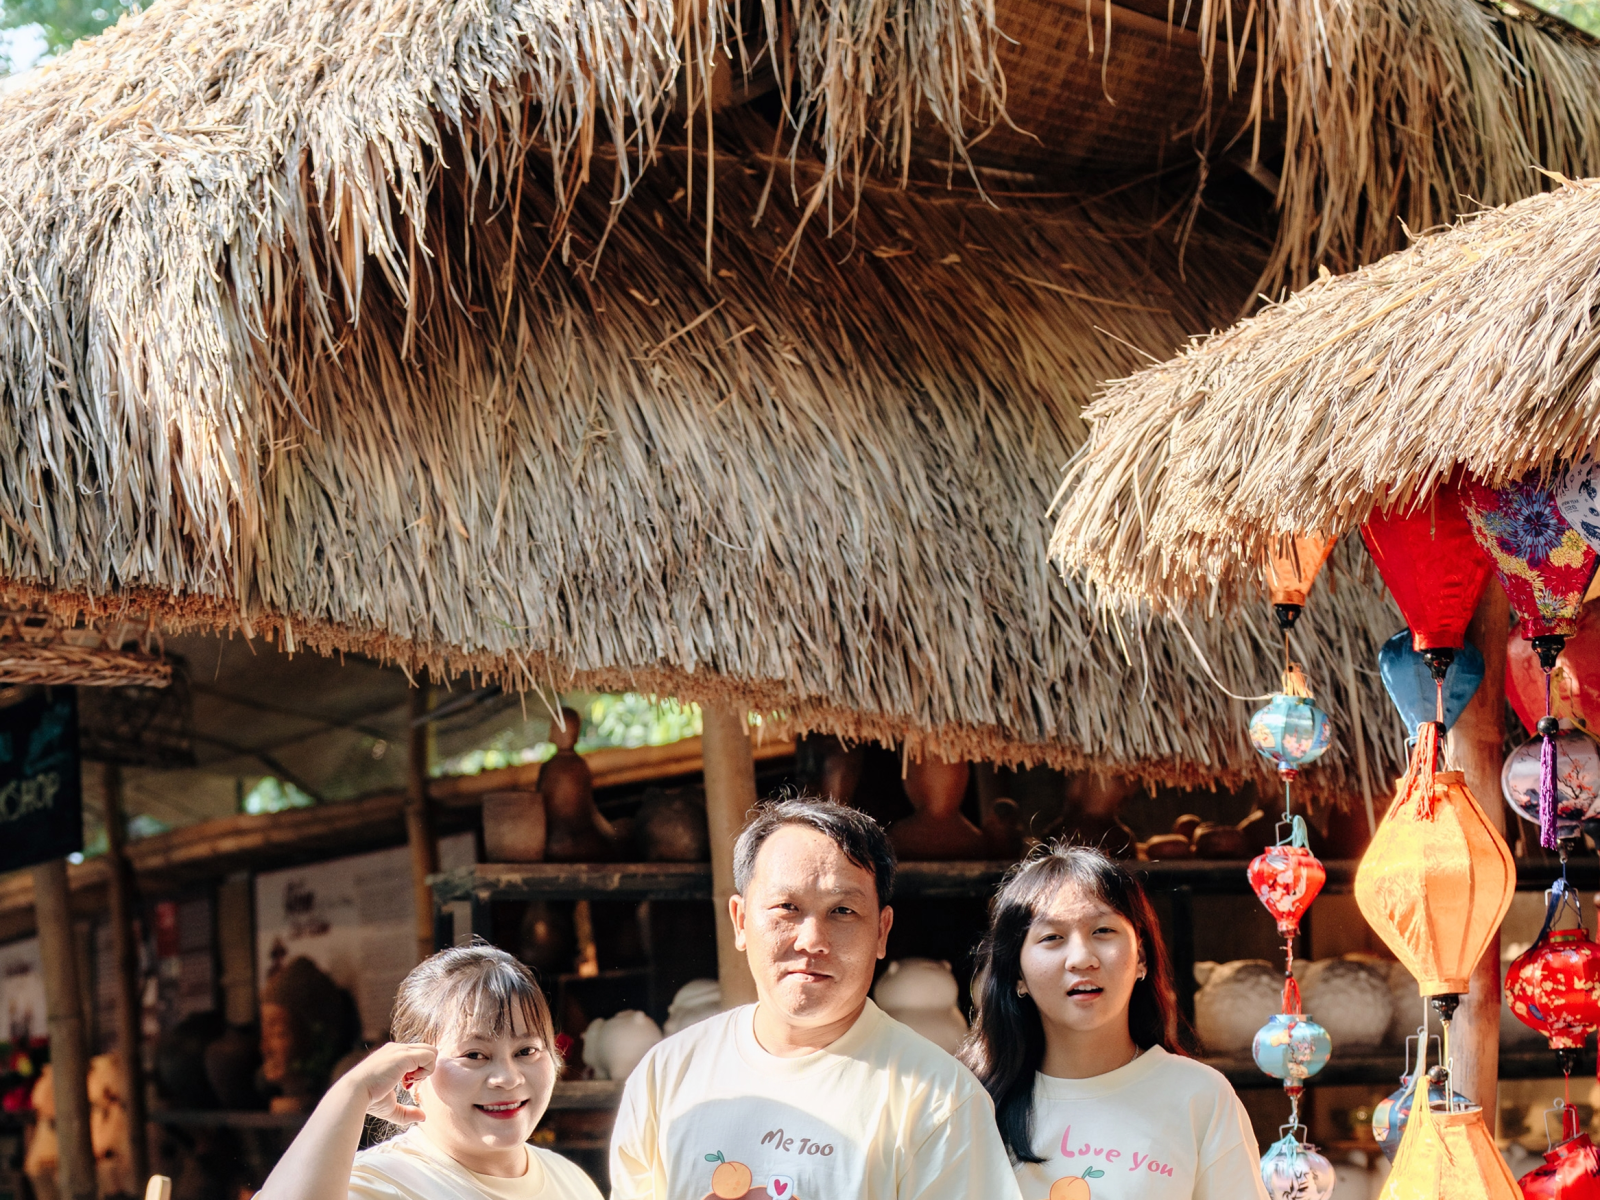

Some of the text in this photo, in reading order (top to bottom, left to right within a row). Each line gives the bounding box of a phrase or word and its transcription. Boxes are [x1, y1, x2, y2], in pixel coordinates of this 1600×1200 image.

[761, 1128, 834, 1156] Me Too
[1060, 1124, 1174, 1177] Love you
